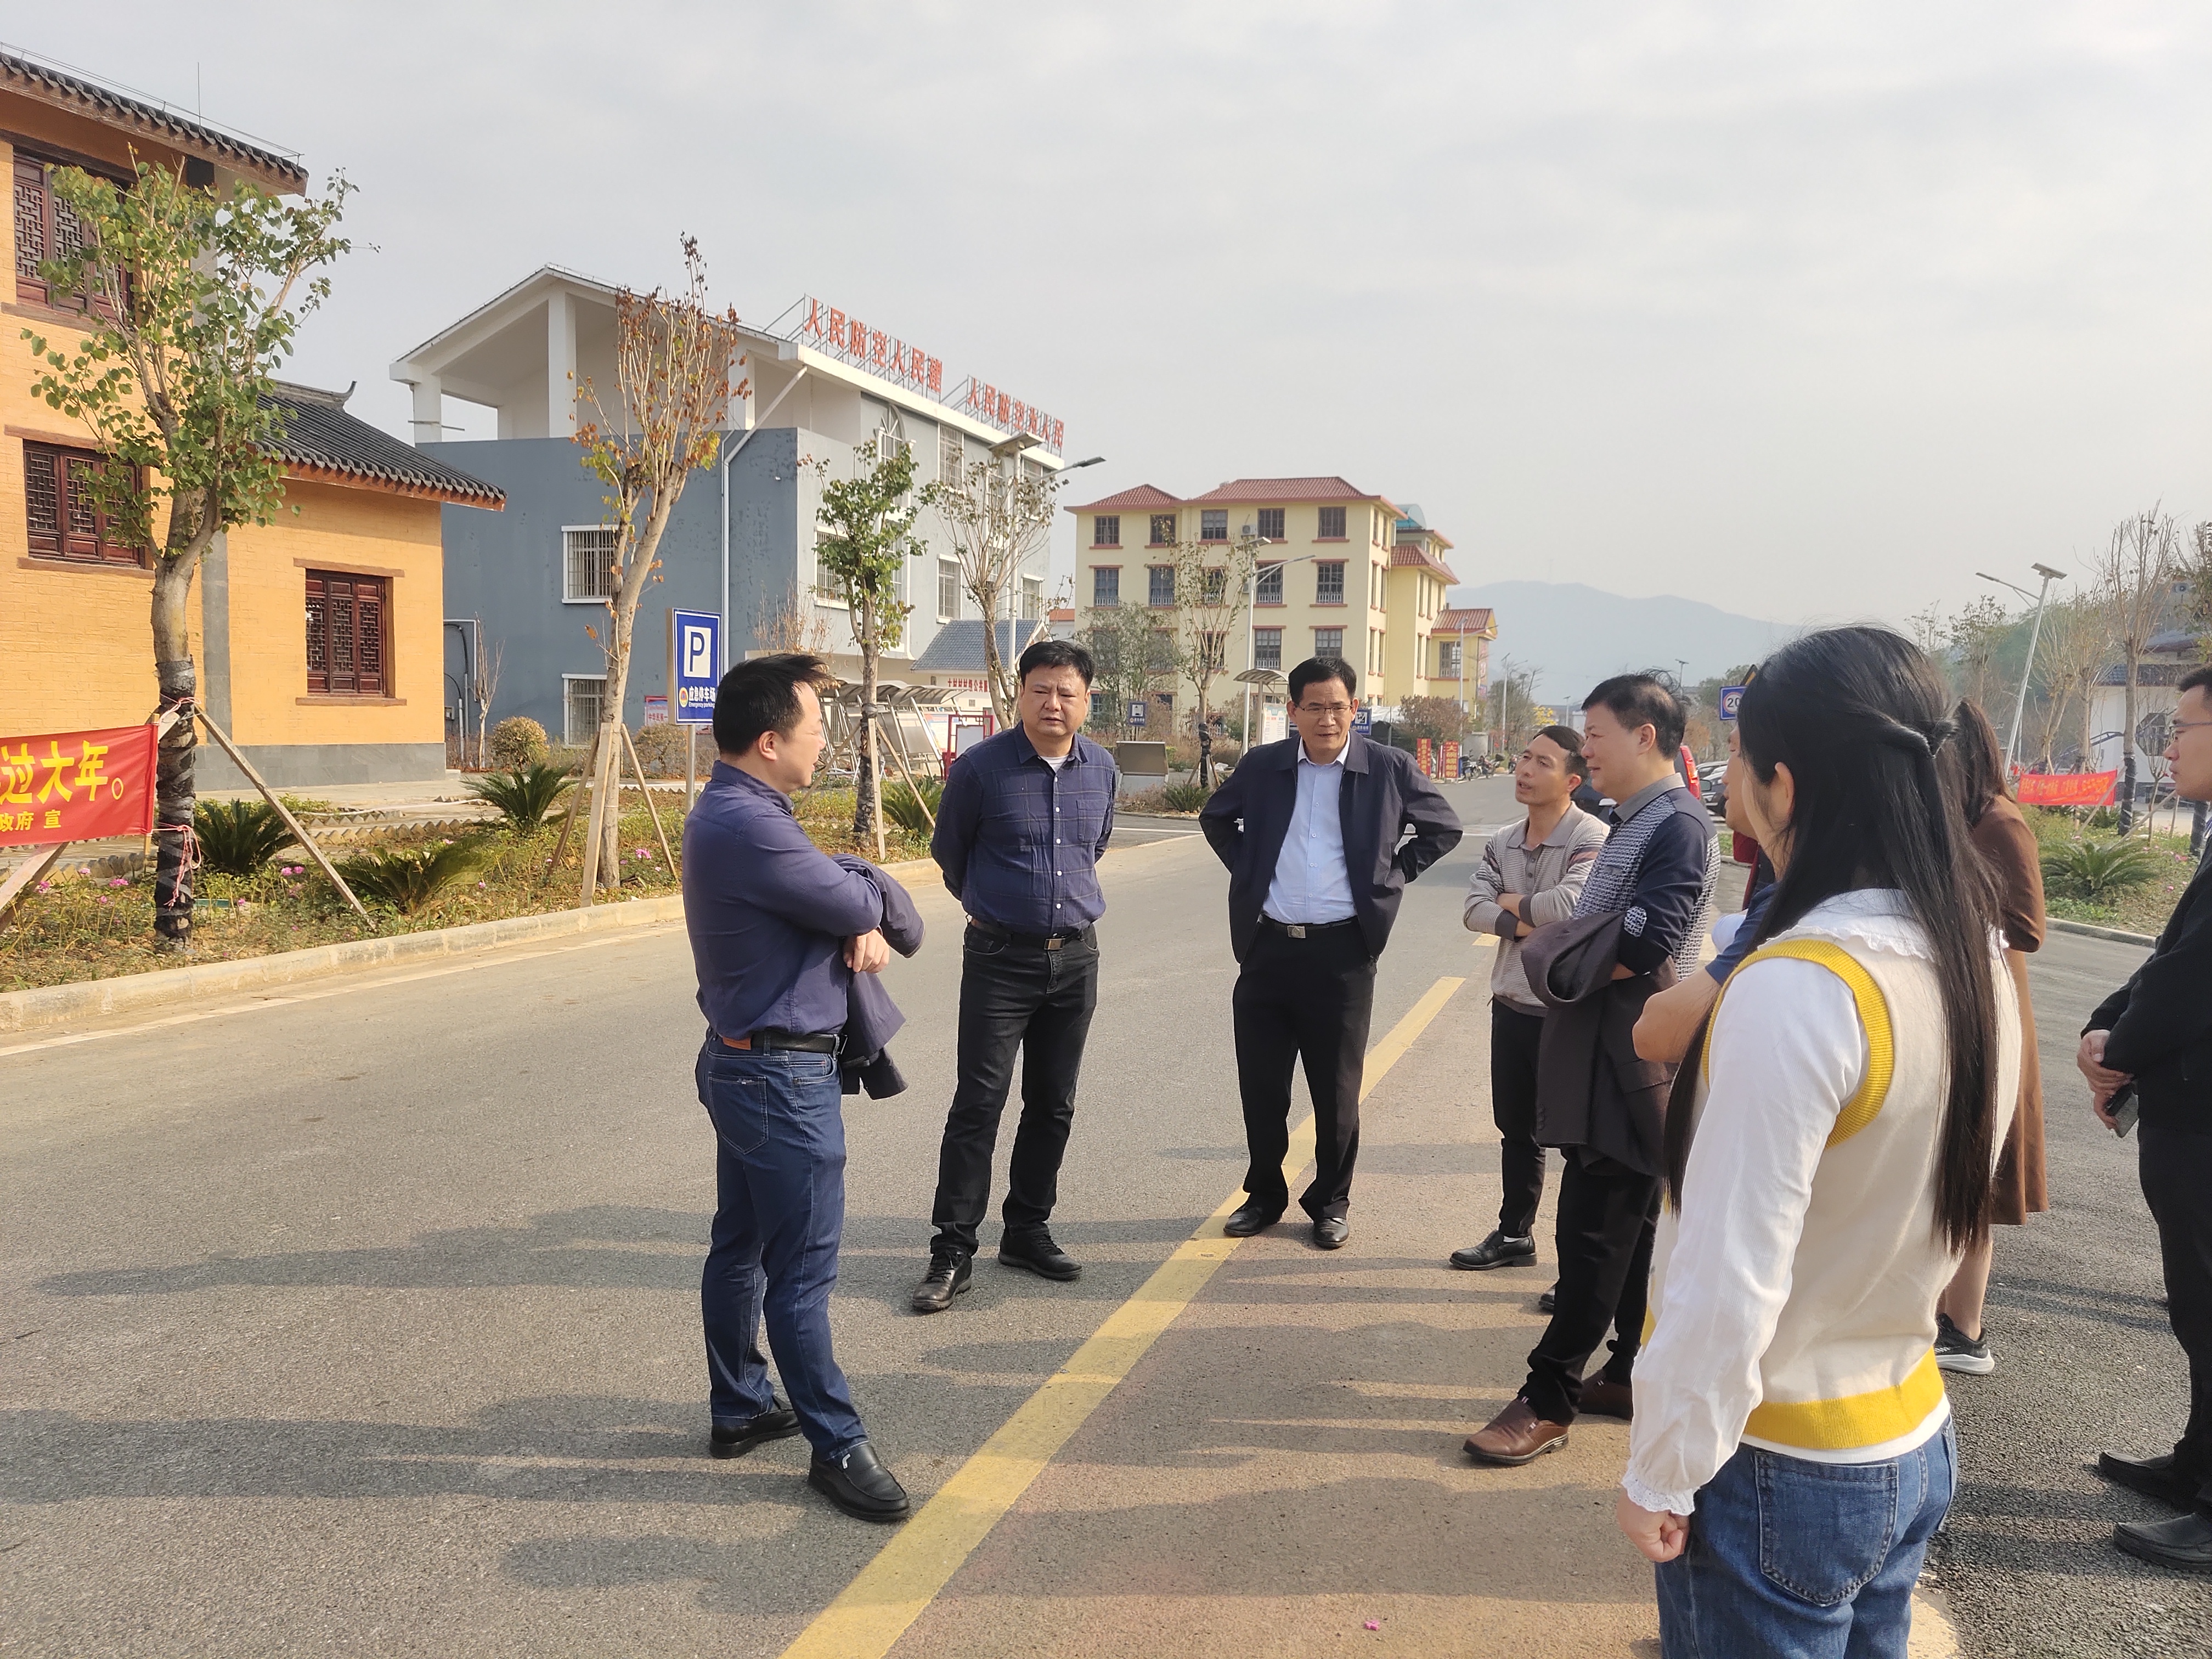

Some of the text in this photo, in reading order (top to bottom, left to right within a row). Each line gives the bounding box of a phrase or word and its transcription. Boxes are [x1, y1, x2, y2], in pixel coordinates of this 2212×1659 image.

[804, 298, 1064, 449] 人民防空人民建 人民防空为人民
[689, 630, 706, 673] P
[689, 686, 716, 702] 应急停车场
[43, 809, 61, 829] 宣
